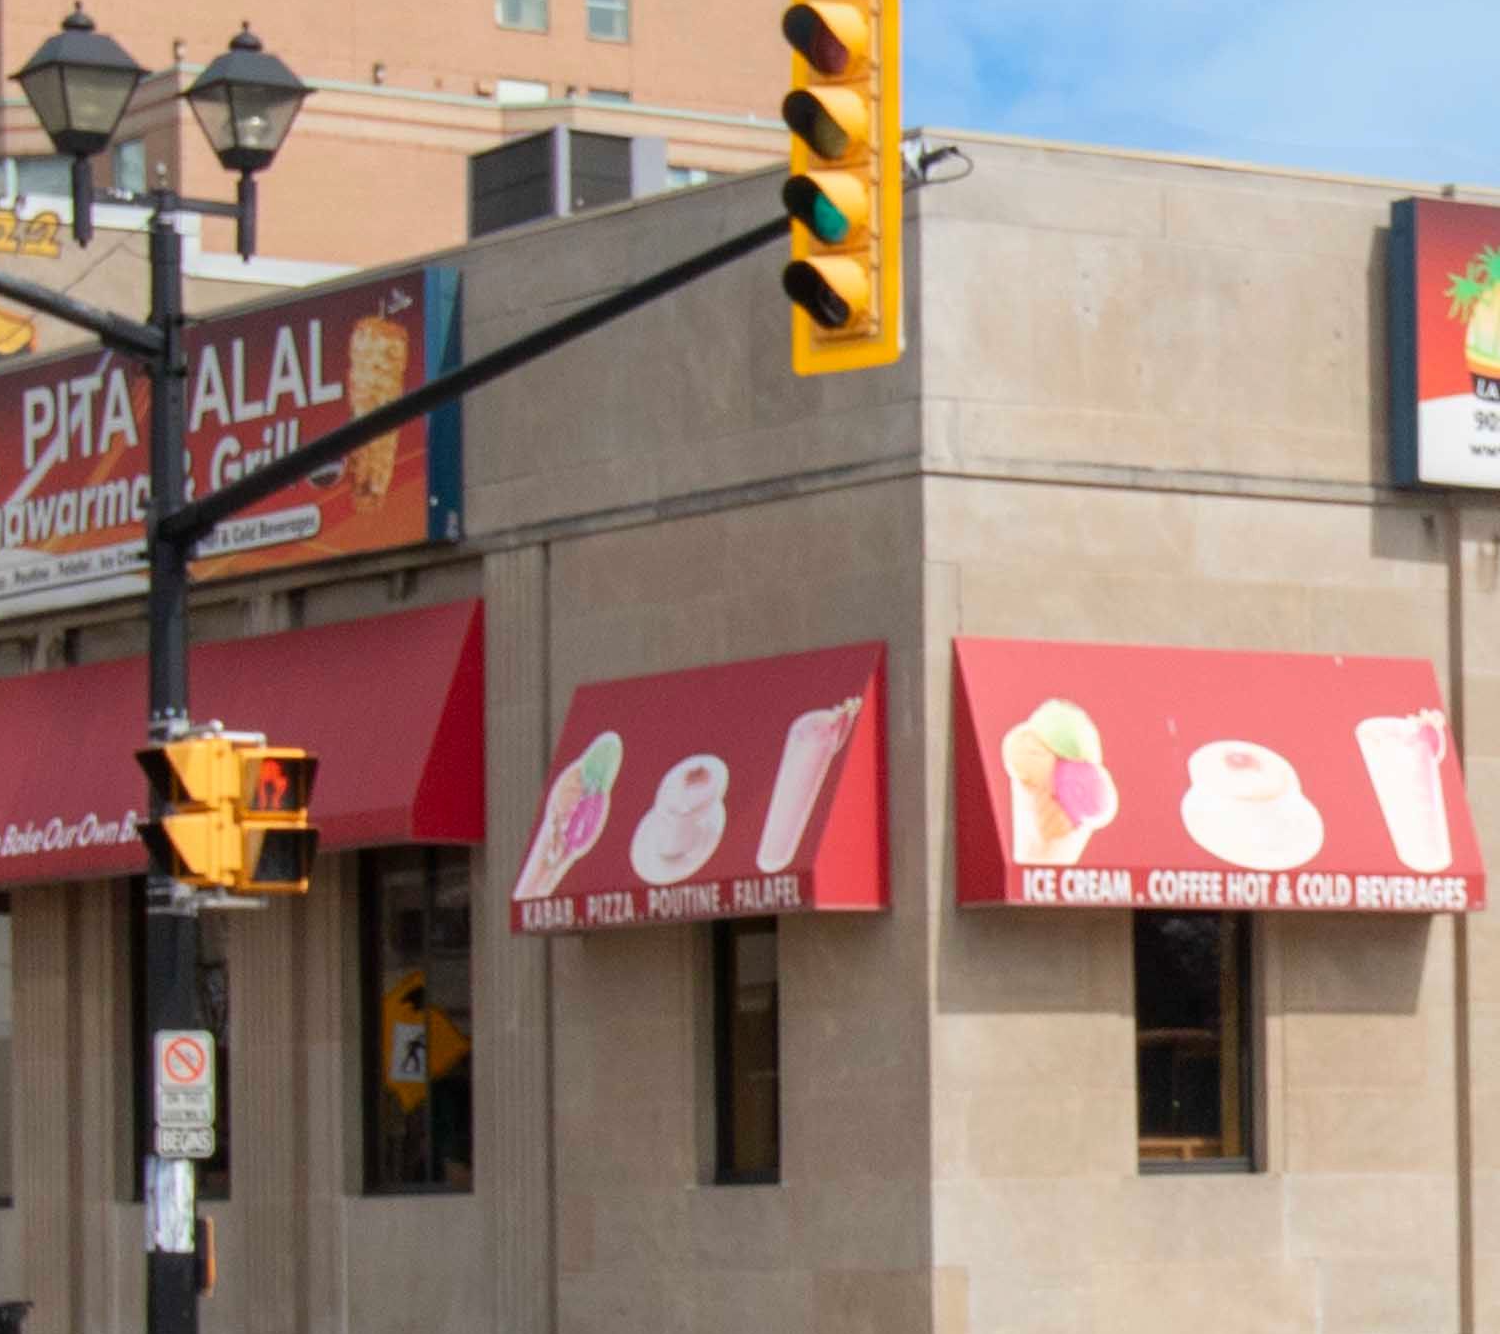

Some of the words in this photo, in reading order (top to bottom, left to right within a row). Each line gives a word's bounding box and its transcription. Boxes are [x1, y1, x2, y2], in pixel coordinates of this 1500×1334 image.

[22, 367, 139, 471] PITA
[187, 318, 345, 434] ALAL
[586, 891, 635, 923] PIZZA
[647, 882, 721, 917] POUTINE
[732, 874, 801, 911] FALAFEL
[1022, 868, 1057, 901] ICE
[1061, 869, 1132, 903] CREAM
[1147, 870, 1223, 905] COFFEE
[1226, 872, 1271, 905] HOT
[1275, 874, 1294, 905] &
[1297, 874, 1352, 907] COLD
[1355, 875, 1468, 909] BEVERAGES
